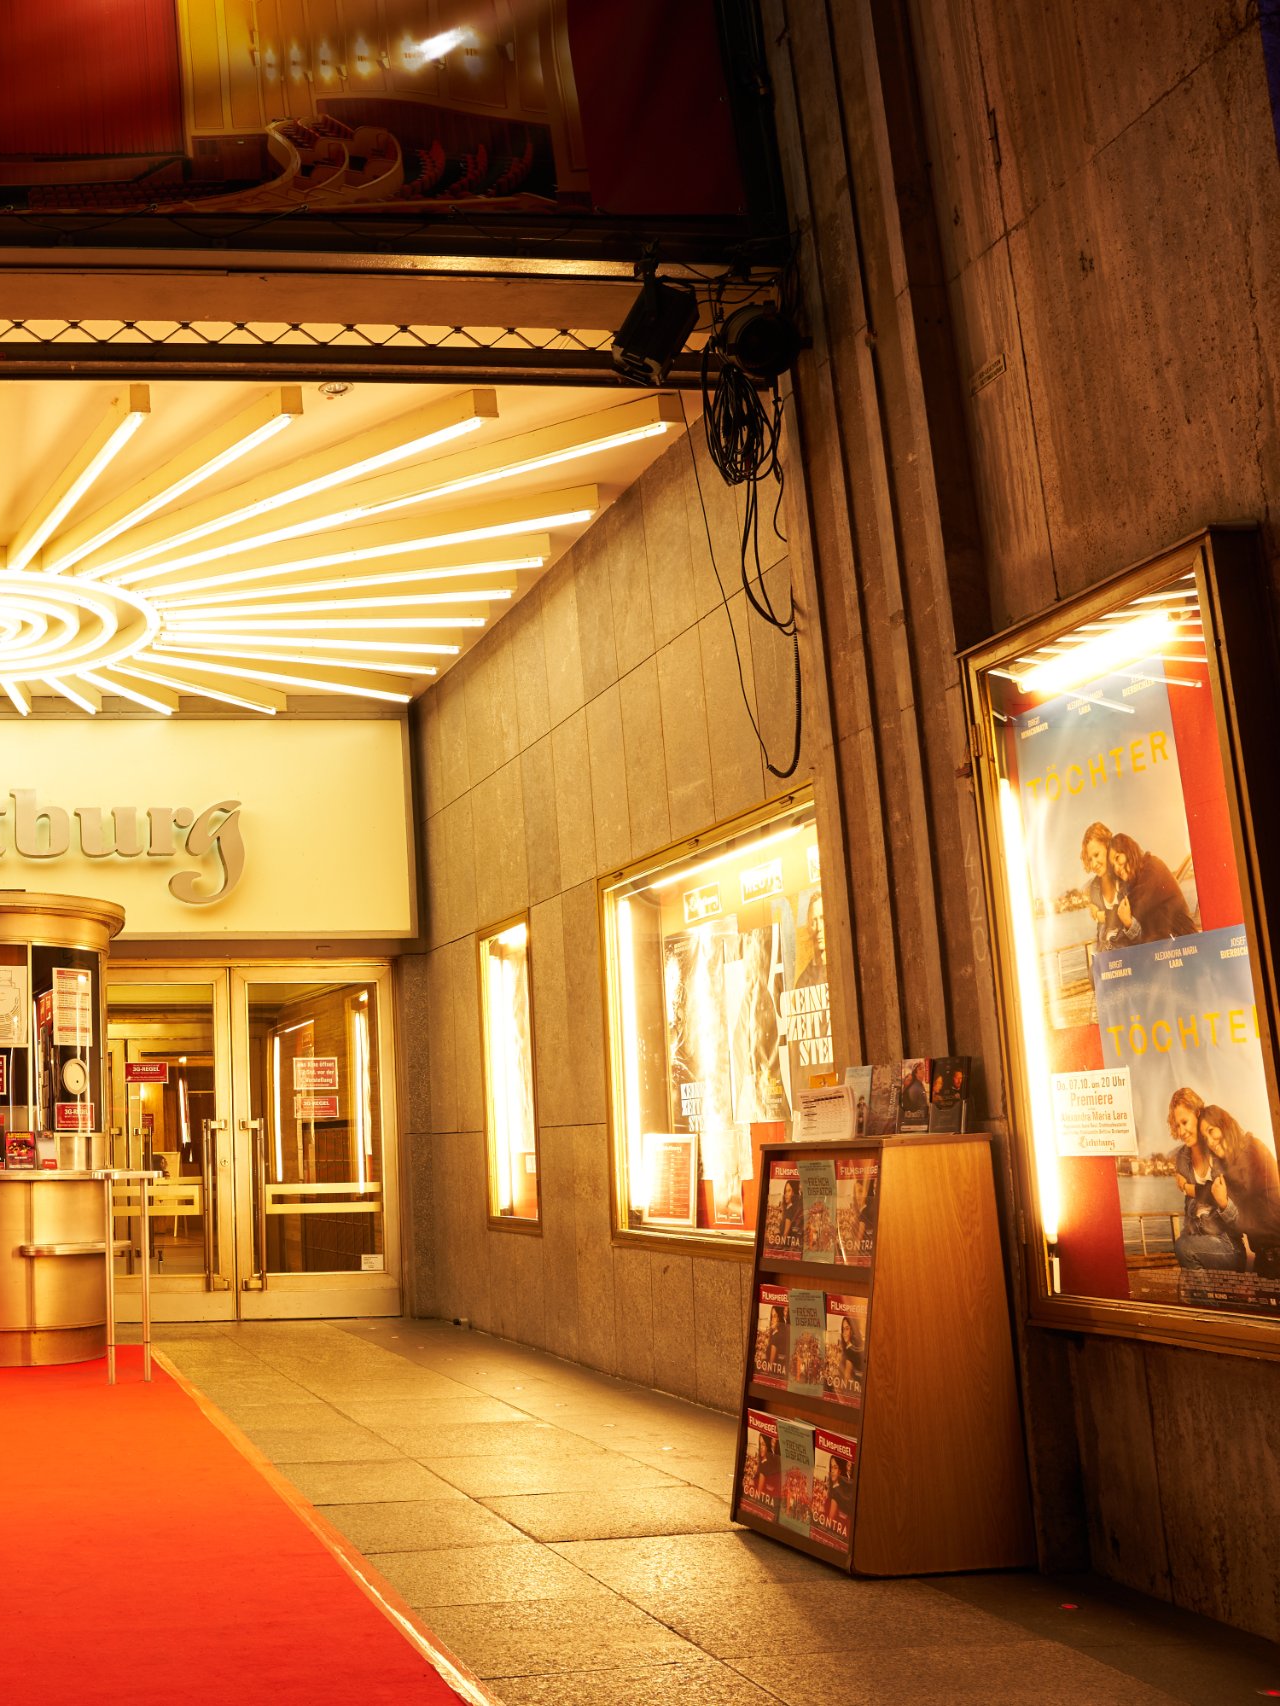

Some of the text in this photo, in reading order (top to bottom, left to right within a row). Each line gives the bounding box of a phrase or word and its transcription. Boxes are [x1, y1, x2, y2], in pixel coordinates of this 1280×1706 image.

[1025, 729, 1169, 801] TÖCHTER
[1230, 935, 1246, 948] JOSEF
[1154, 945, 1198, 961] ALEXANDRA MARIA
[1168, 958, 1184, 969] LARA
[1101, 1076, 1110, 1088] 20
[1112, 1075, 1126, 1087] Uhr
[1070, 1090, 1113, 1107] Premiere
[1092, 1110, 1112, 1121] Maria
[1112, 1110, 1128, 1120] Lara
[768, 1235, 800, 1246] CONTRA
[756, 1360, 786, 1375] CONTRA
[749, 1415, 778, 1435] FILMSPIEGEL
[818, 1435, 853, 1457] FILMSPIEGEL
[743, 1485, 775, 1507] CONTRA
[812, 1511, 848, 1537] CONTRA
